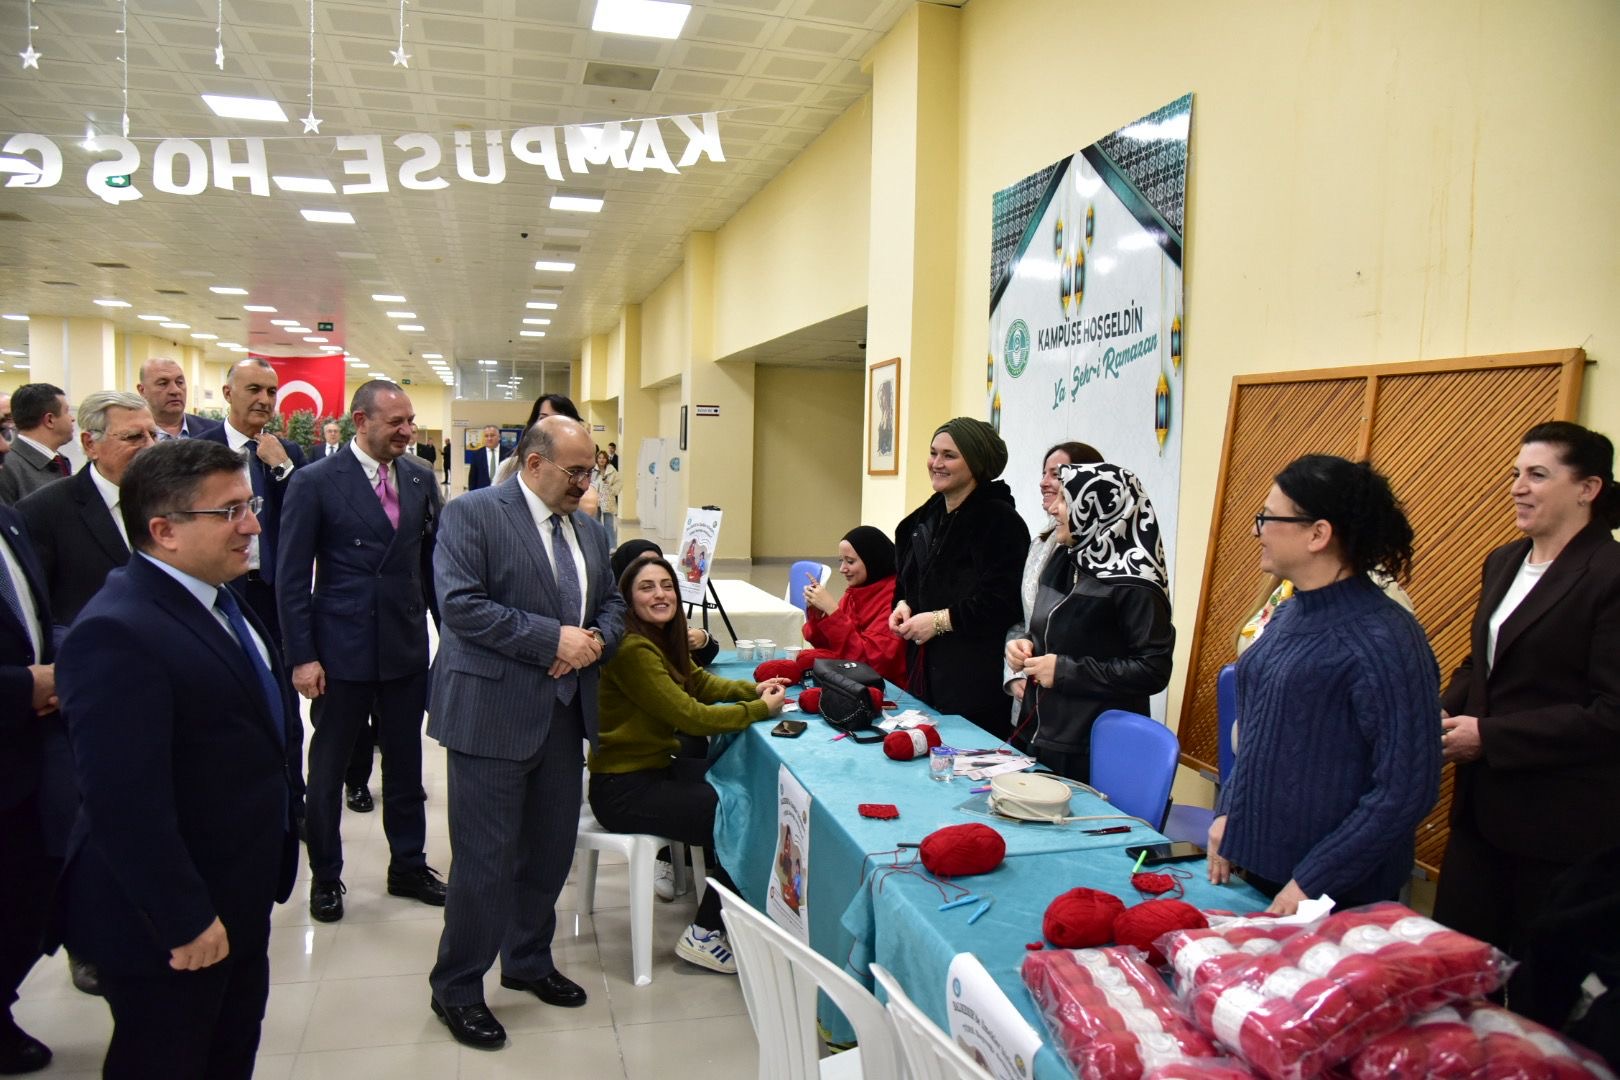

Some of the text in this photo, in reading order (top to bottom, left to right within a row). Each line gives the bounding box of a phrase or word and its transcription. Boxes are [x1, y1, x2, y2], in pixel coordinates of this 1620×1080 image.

[1038, 316, 1082, 352] KAMPÜSE
[1083, 299, 1143, 348] HOŞGELDİN
[1052, 333, 1159, 410] Ya Şehri Ramazan
